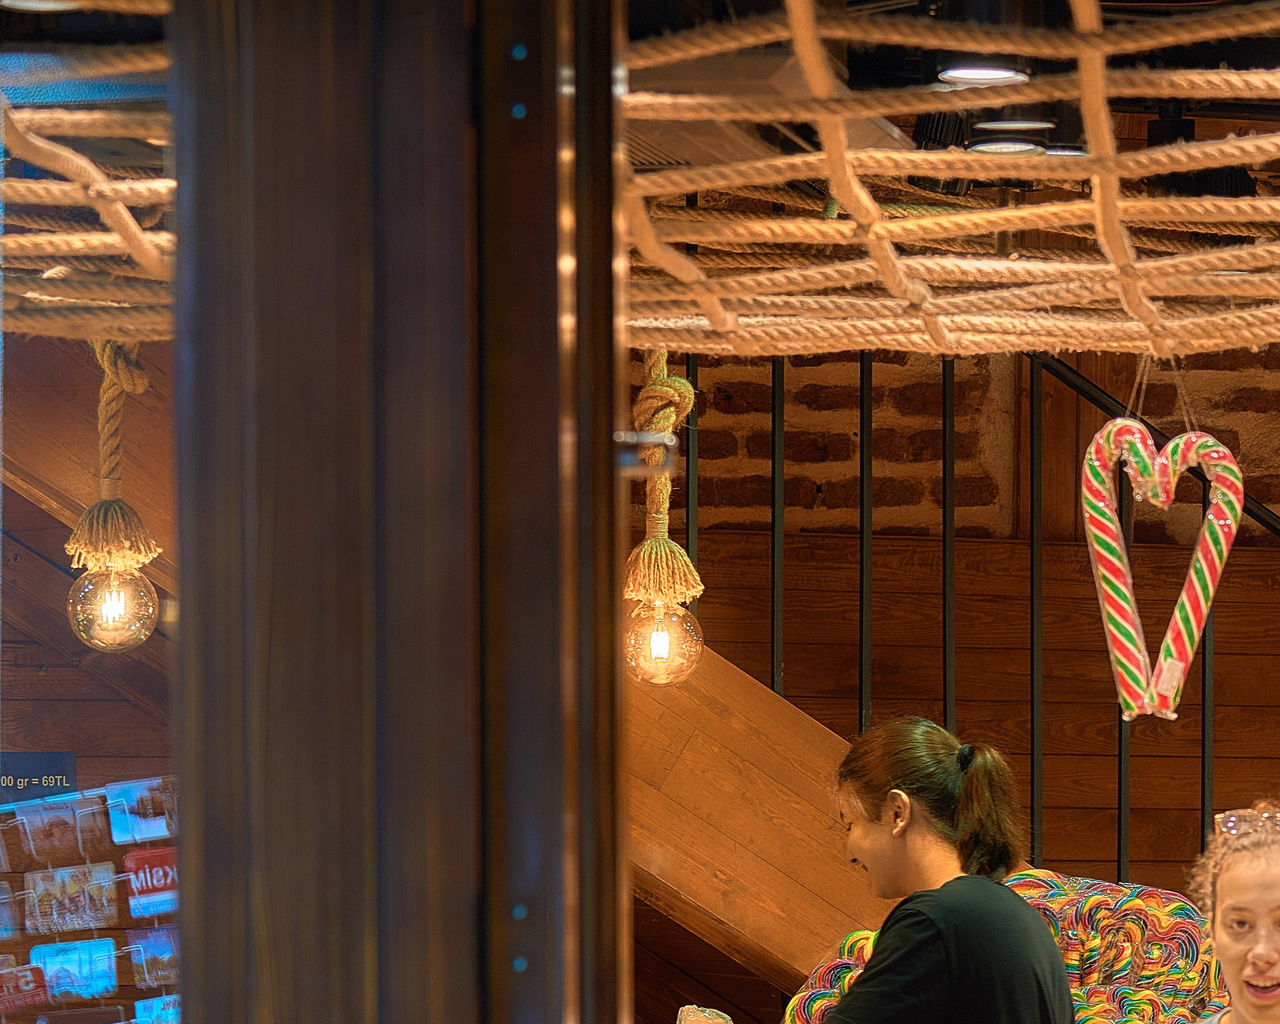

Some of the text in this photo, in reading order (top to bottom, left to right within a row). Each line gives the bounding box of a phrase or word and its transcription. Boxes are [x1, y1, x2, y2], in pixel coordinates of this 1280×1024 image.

[0, 775, 14, 787] 00
[16, 778, 30, 790] gr
[41, 775, 71, 787] 69TL
